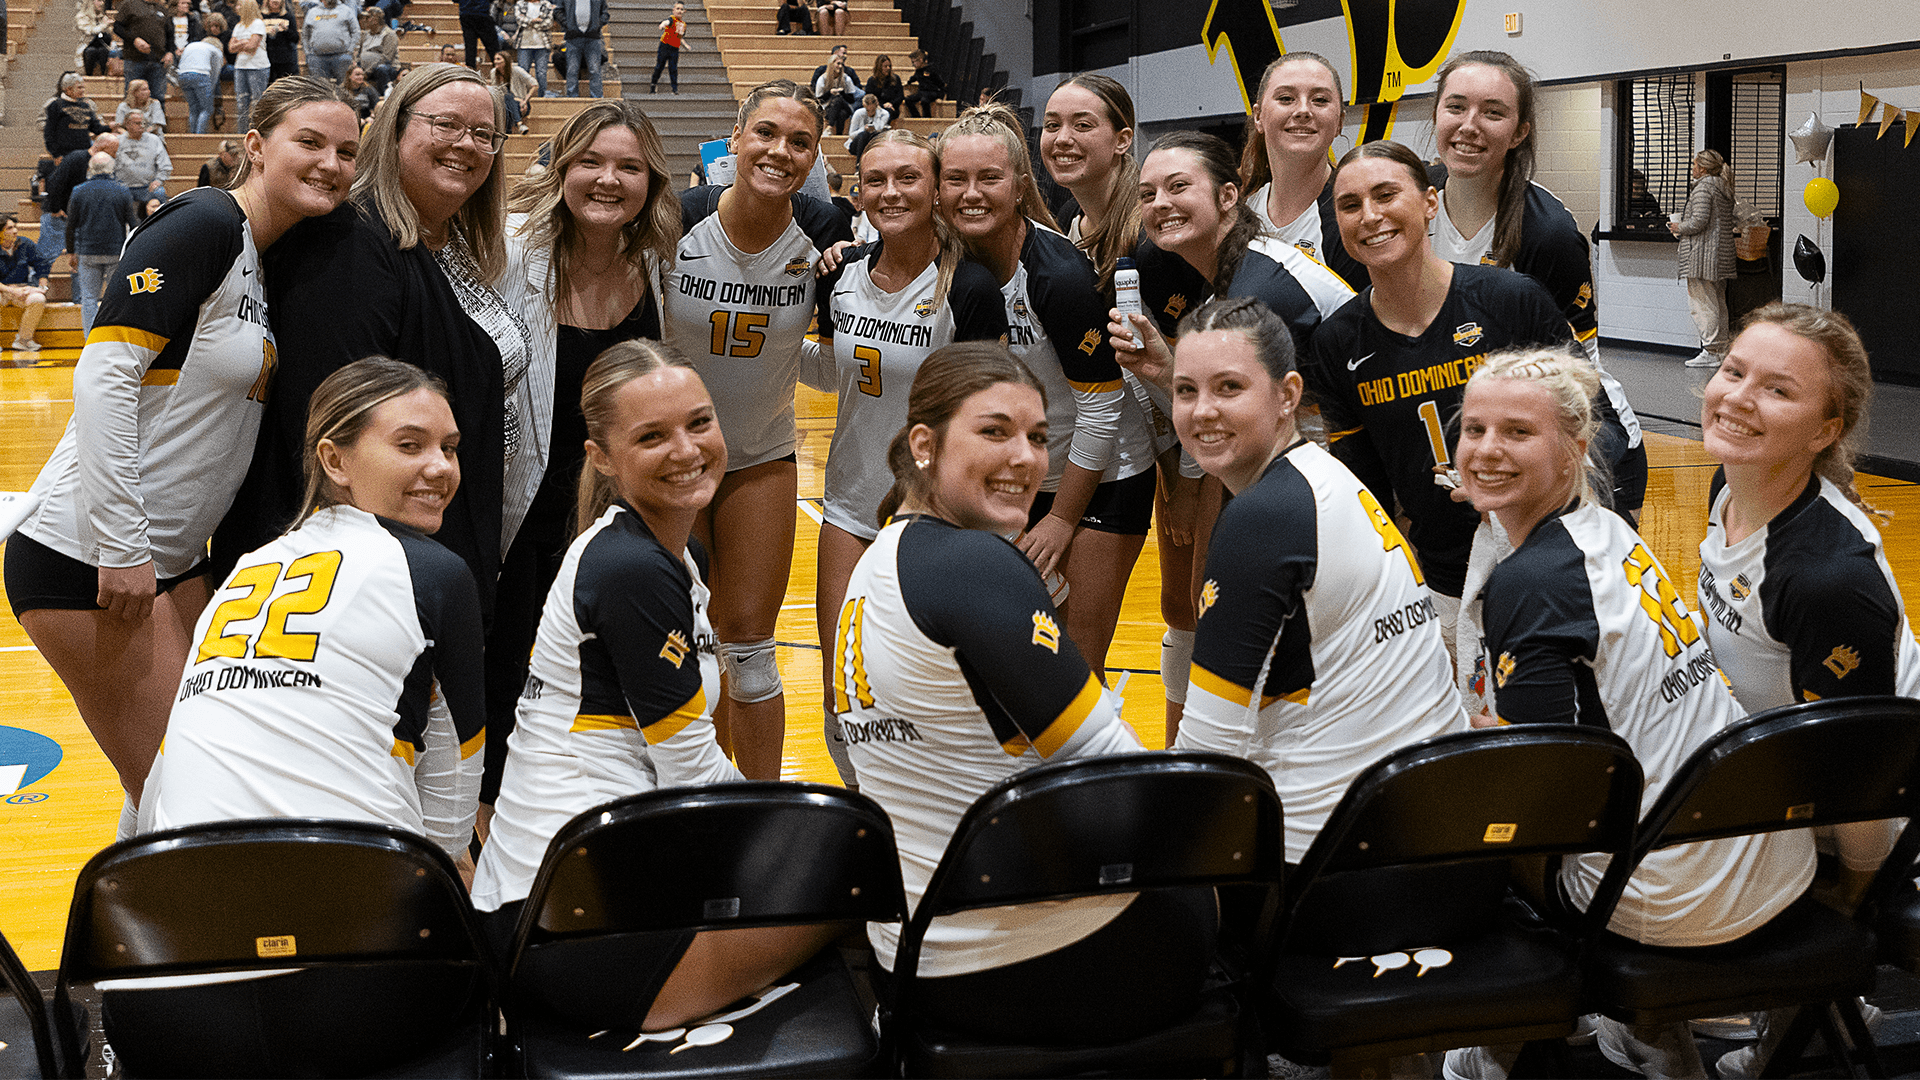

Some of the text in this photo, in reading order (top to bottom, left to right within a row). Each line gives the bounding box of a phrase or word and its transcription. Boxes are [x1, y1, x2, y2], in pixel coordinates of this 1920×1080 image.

[1387, 71, 1401, 88] TM
[680, 273, 807, 307] OHIO DOMINICAN
[709, 310, 770, 358] 15
[853, 316, 933, 348] DOMINICAN
[853, 344, 883, 398] 3
[1357, 376, 1396, 406] OHIO
[1417, 400, 1450, 465] 1
[194, 550, 344, 666] 22
[1374, 610, 1405, 644] OHIO
[834, 596, 876, 714] 11
[179, 665, 323, 703] OHIO DOMINICAN
[1660, 667, 1689, 704] OHIO
